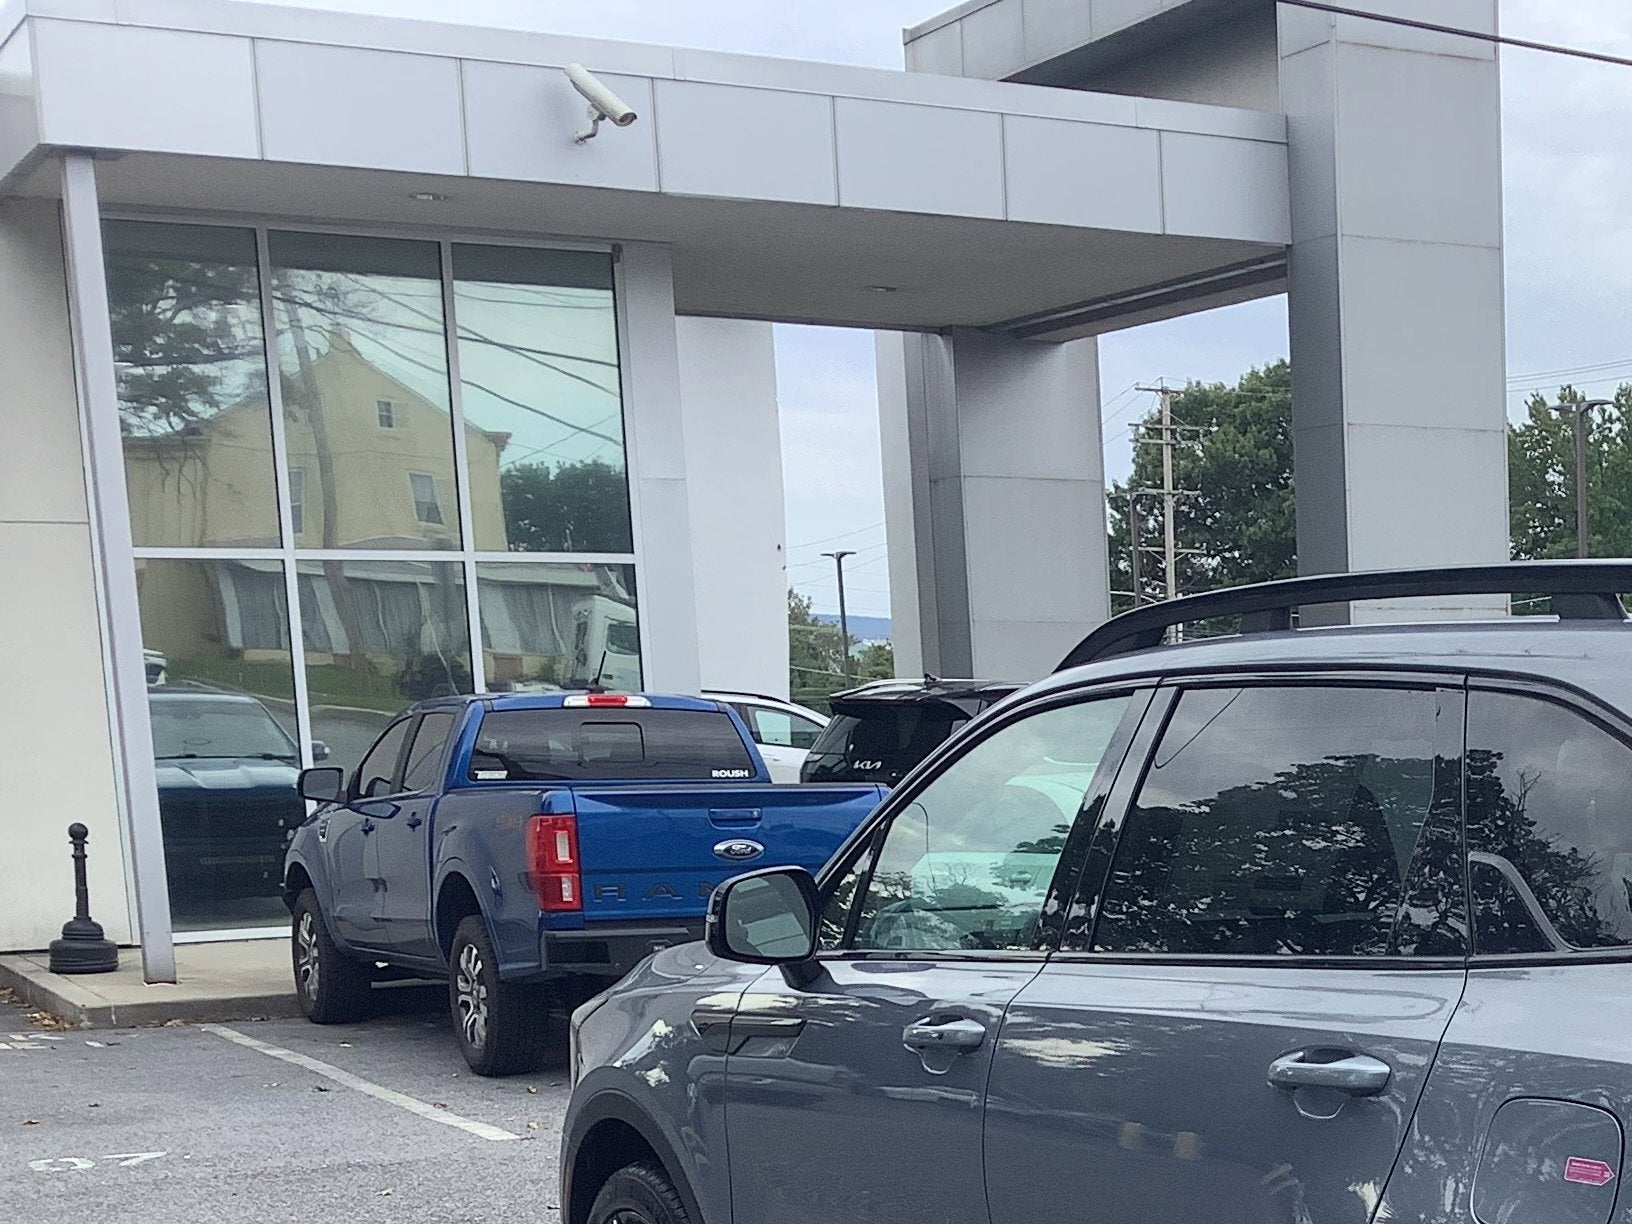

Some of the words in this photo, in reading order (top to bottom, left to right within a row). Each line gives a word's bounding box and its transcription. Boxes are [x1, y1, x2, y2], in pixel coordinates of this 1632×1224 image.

[853, 760, 882, 769] KIA
[711, 769, 749, 778] ROUSH
[730, 844, 752, 855] Ford
